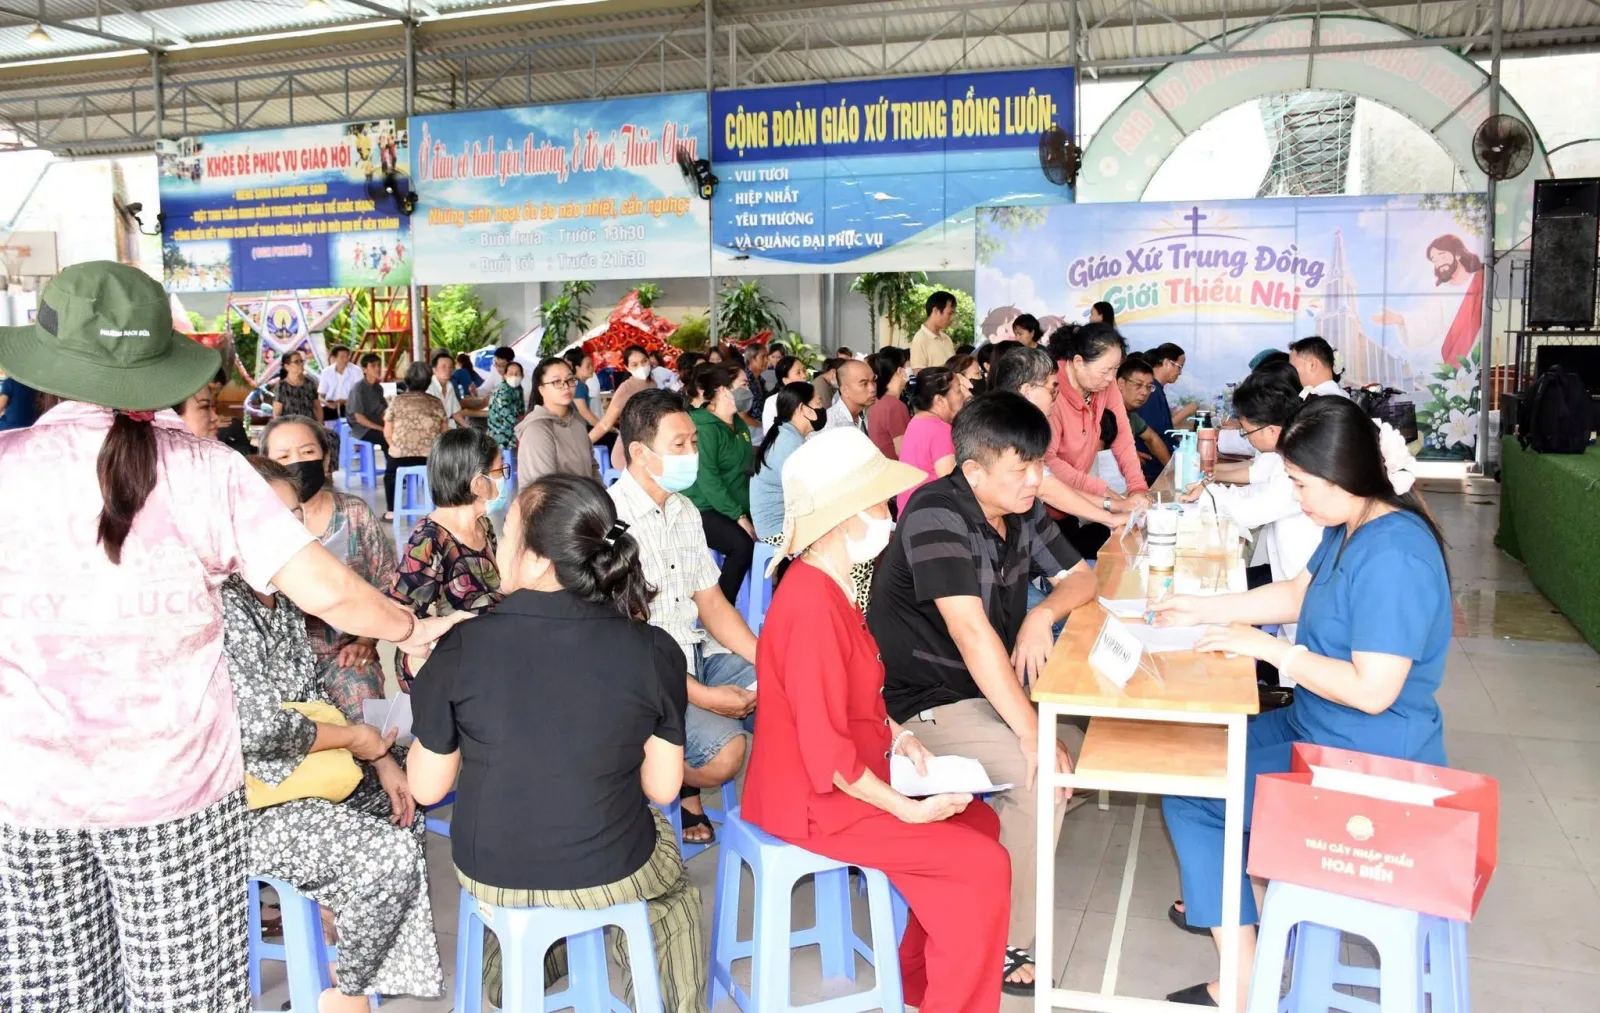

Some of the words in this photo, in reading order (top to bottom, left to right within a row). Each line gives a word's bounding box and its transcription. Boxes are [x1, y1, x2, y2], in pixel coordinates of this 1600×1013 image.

[725, 105, 768, 157] CỘNG
[772, 101, 817, 148] ĐOÀN
[821, 98, 859, 144] GIÁO
[864, 95, 889, 142] XỨ
[891, 99, 947, 140] TRUNG
[951, 85, 1000, 138] ĐỒNG
[1005, 86, 1057, 135] LUÔN:
[253, 150, 281, 178] PHỤC
[283, 150, 298, 177] VỤ
[300, 143, 328, 170] GIÁO
[330, 141, 352, 173] HỘI
[419, 121, 432, 181] Ở
[432, 139, 454, 181] đâu
[457, 141, 469, 179] có
[471, 134, 497, 178] tình
[499, 138, 520, 187] yêu
[523, 132, 569, 184] thương,
[572, 128, 581, 173] ở
[583, 127, 599, 172] đó
[602, 130, 616, 170] có
[621, 123, 658, 168] Thiên
[662, 120, 698, 166] Chúa
[735, 170, 756, 182] VUI
[759, 167, 789, 182] TƯƠI
[735, 190, 763, 207] HIỆP
[765, 185, 799, 203] NHẤT
[428, 205, 465, 228] Những
[468, 206, 492, 224] sinh
[494, 204, 520, 224] hoạt
[558, 199, 581, 218] náo
[584, 198, 617, 220] nhiệt,
[620, 193, 643, 216] cần
[735, 211, 758, 227] YÊU
[761, 211, 814, 226] THƯƠNG
[481, 226, 511, 247] Buổi
[515, 231, 542, 245] trưa
[559, 227, 597, 243] Trước
[603, 224, 645, 242] 13h30
[735, 233, 752, 249] VÀ
[754, 231, 800, 251] QUẢNG
[802, 234, 825, 250] ĐẠI
[828, 230, 863, 249] PHỤC
[865, 233, 883, 249] VỤ
[481, 252, 511, 273] Buổi
[515, 252, 534, 271] tối
[557, 252, 597, 269] Trước
[602, 251, 645, 269] 21h30
[1068, 255, 1122, 289] Giáo
[1125, 246, 1163, 275] Xứ
[1167, 243, 1248, 278] Trung
[1254, 244, 1325, 288] Đồng
[1102, 282, 1158, 315] Giới
[1164, 271, 1242, 304] Thiếu
[1251, 280, 1300, 311] Nhi
[1304, 838, 1327, 851] TRÁI
[1329, 843, 1351, 856] CÂY
[1352, 847, 1383, 863] NHẬP
[1321, 856, 1355, 876] HOA
[1359, 862, 1394, 884] BIỂN
